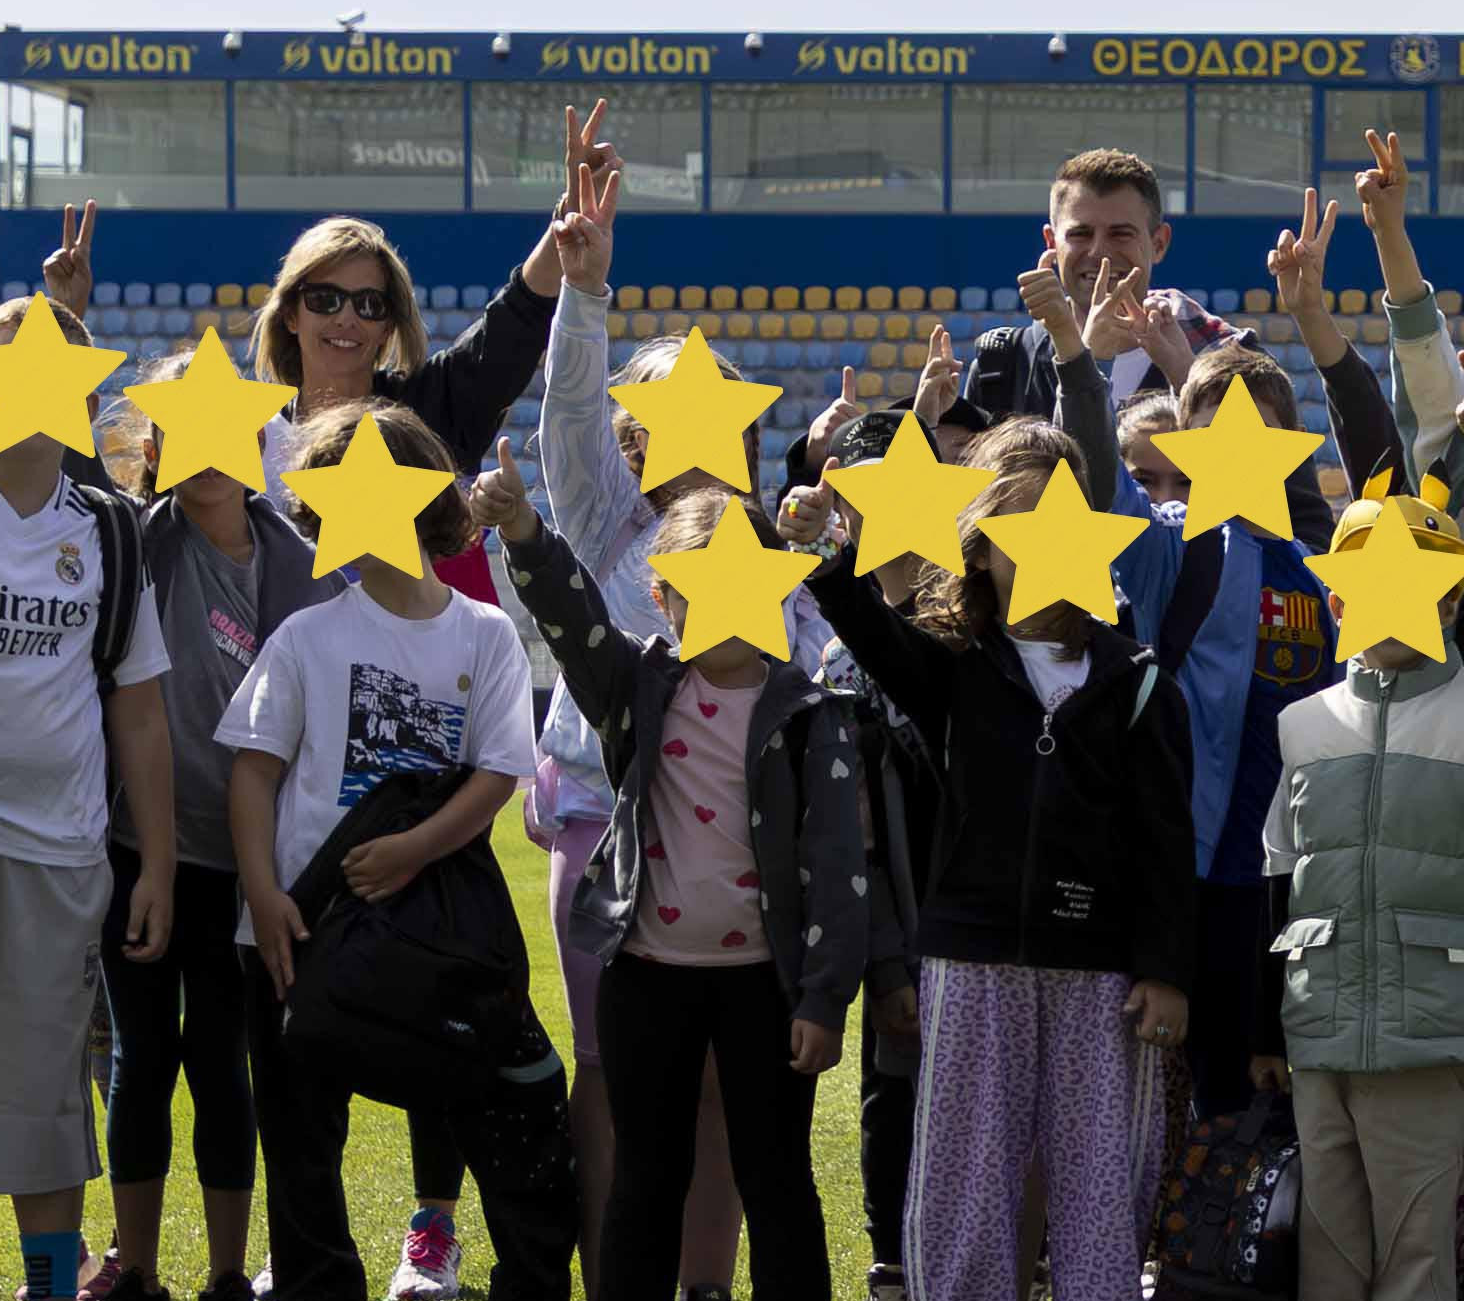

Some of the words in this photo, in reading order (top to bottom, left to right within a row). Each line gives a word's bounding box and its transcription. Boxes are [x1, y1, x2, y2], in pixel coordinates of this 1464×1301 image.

[59, 35, 191, 72] volton
[320, 35, 451, 73] volton
[577, 37, 710, 73] volton
[835, 37, 969, 73] volton
[1093, 39, 1367, 76] ΘΕΟΔΩΡΟΣ
